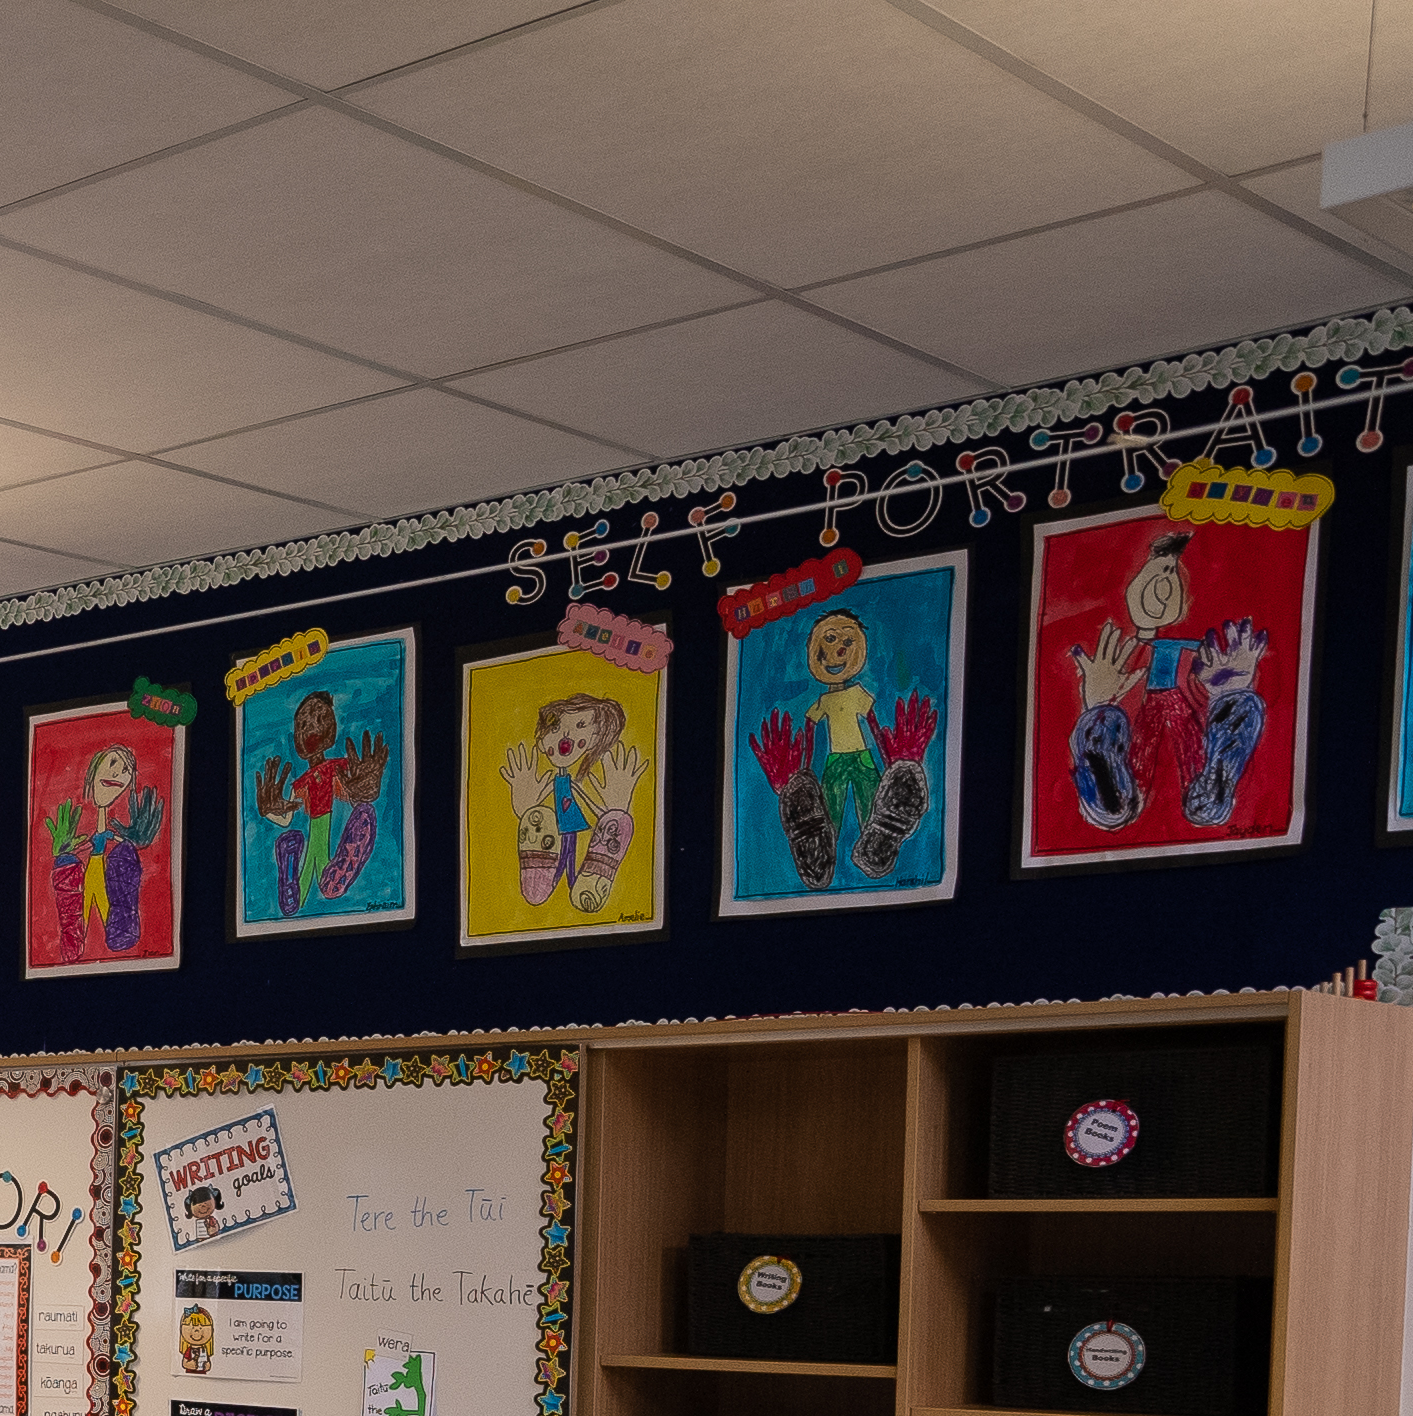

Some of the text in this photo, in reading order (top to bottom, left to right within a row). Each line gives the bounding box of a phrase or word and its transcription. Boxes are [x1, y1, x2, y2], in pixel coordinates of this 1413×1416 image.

[506, 492, 740, 604] SELF
[1091, 1119, 1118, 1132] Poem
[1084, 1127, 1114, 1142] Books
[169, 1136, 271, 1192] WRITING
[233, 1164, 275, 1197] goals
[347, 1194, 397, 1231] Tere
[411, 1196, 450, 1227] the
[757, 1271, 787, 1283] Writing
[234, 1284, 299, 1300] PURPOSE
[335, 1269, 534, 1306] Taitū the Takahē
[756, 1281, 783, 1291] Books
[38, 1311, 77, 1322] raumati
[36, 1343, 75, 1355] takurua
[378, 1335, 410, 1353] wera
[41, 1377, 77, 1394] kōanga
